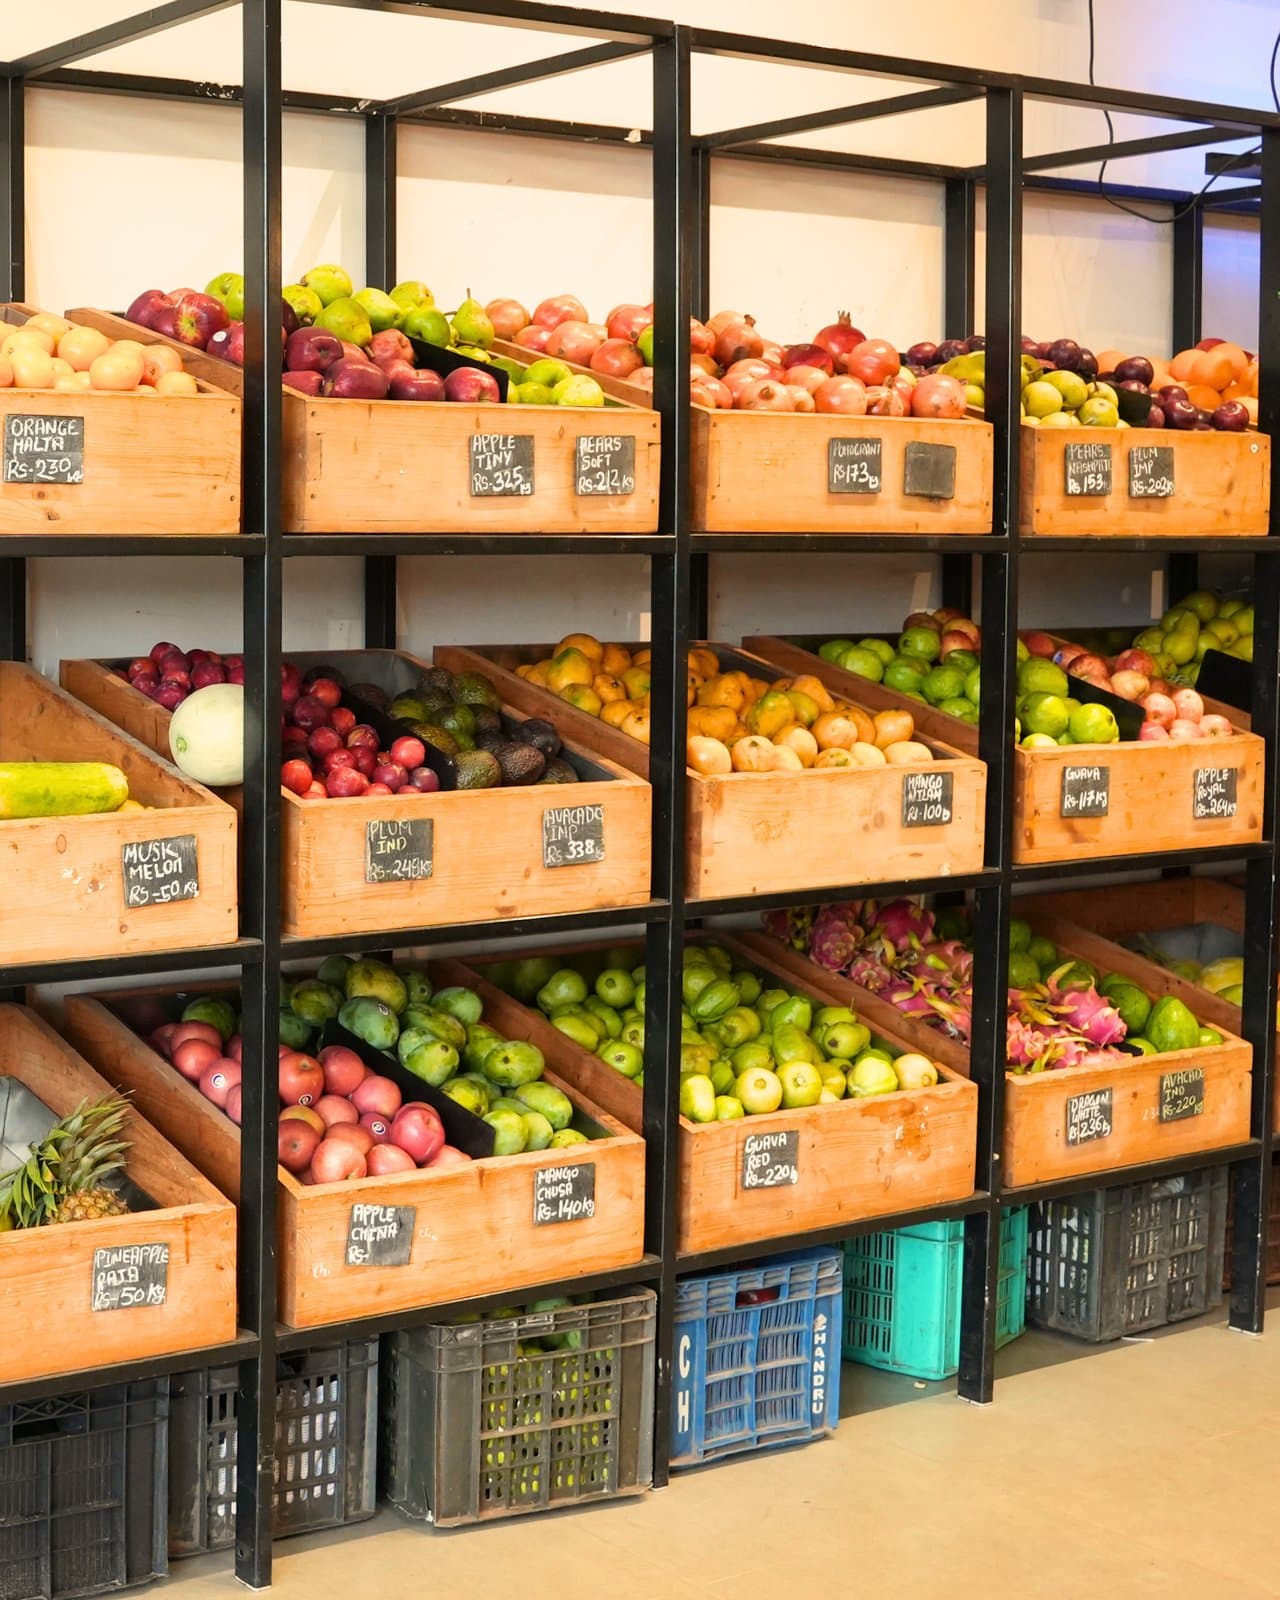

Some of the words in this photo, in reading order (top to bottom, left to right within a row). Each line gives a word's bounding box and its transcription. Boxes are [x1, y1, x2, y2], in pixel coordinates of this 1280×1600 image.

[11, 418, 80, 437] ORANGE
[12, 435, 64, 455] MALTA
[473, 434, 516, 453] APPLE
[580, 437, 622, 456] PEARS
[475, 450, 512, 470] TINY
[1133, 447, 1158, 463] PLUM
[1133, 460, 1154, 478] IMP
[907, 773, 943, 790] MANGO
[1065, 767, 1101, 781] GUAVA
[1197, 767, 1229, 783] APPLE
[545, 806, 604, 827] AVACADO
[369, 819, 413, 842] PLUM
[124, 841, 178, 864] MUSK
[376, 837, 407, 855] IND
[1165, 1086, 1185, 1103] IND
[745, 1132, 787, 1154] GUAVA
[747, 1152, 771, 1171] RED
[537, 1166, 579, 1185] MANGO
[536, 1182, 573, 1202] CHUSA
[352, 1204, 396, 1226] APPLE
[351, 1222, 398, 1242] CHINA
[96, 1244, 169, 1268] PINEAPPLE
